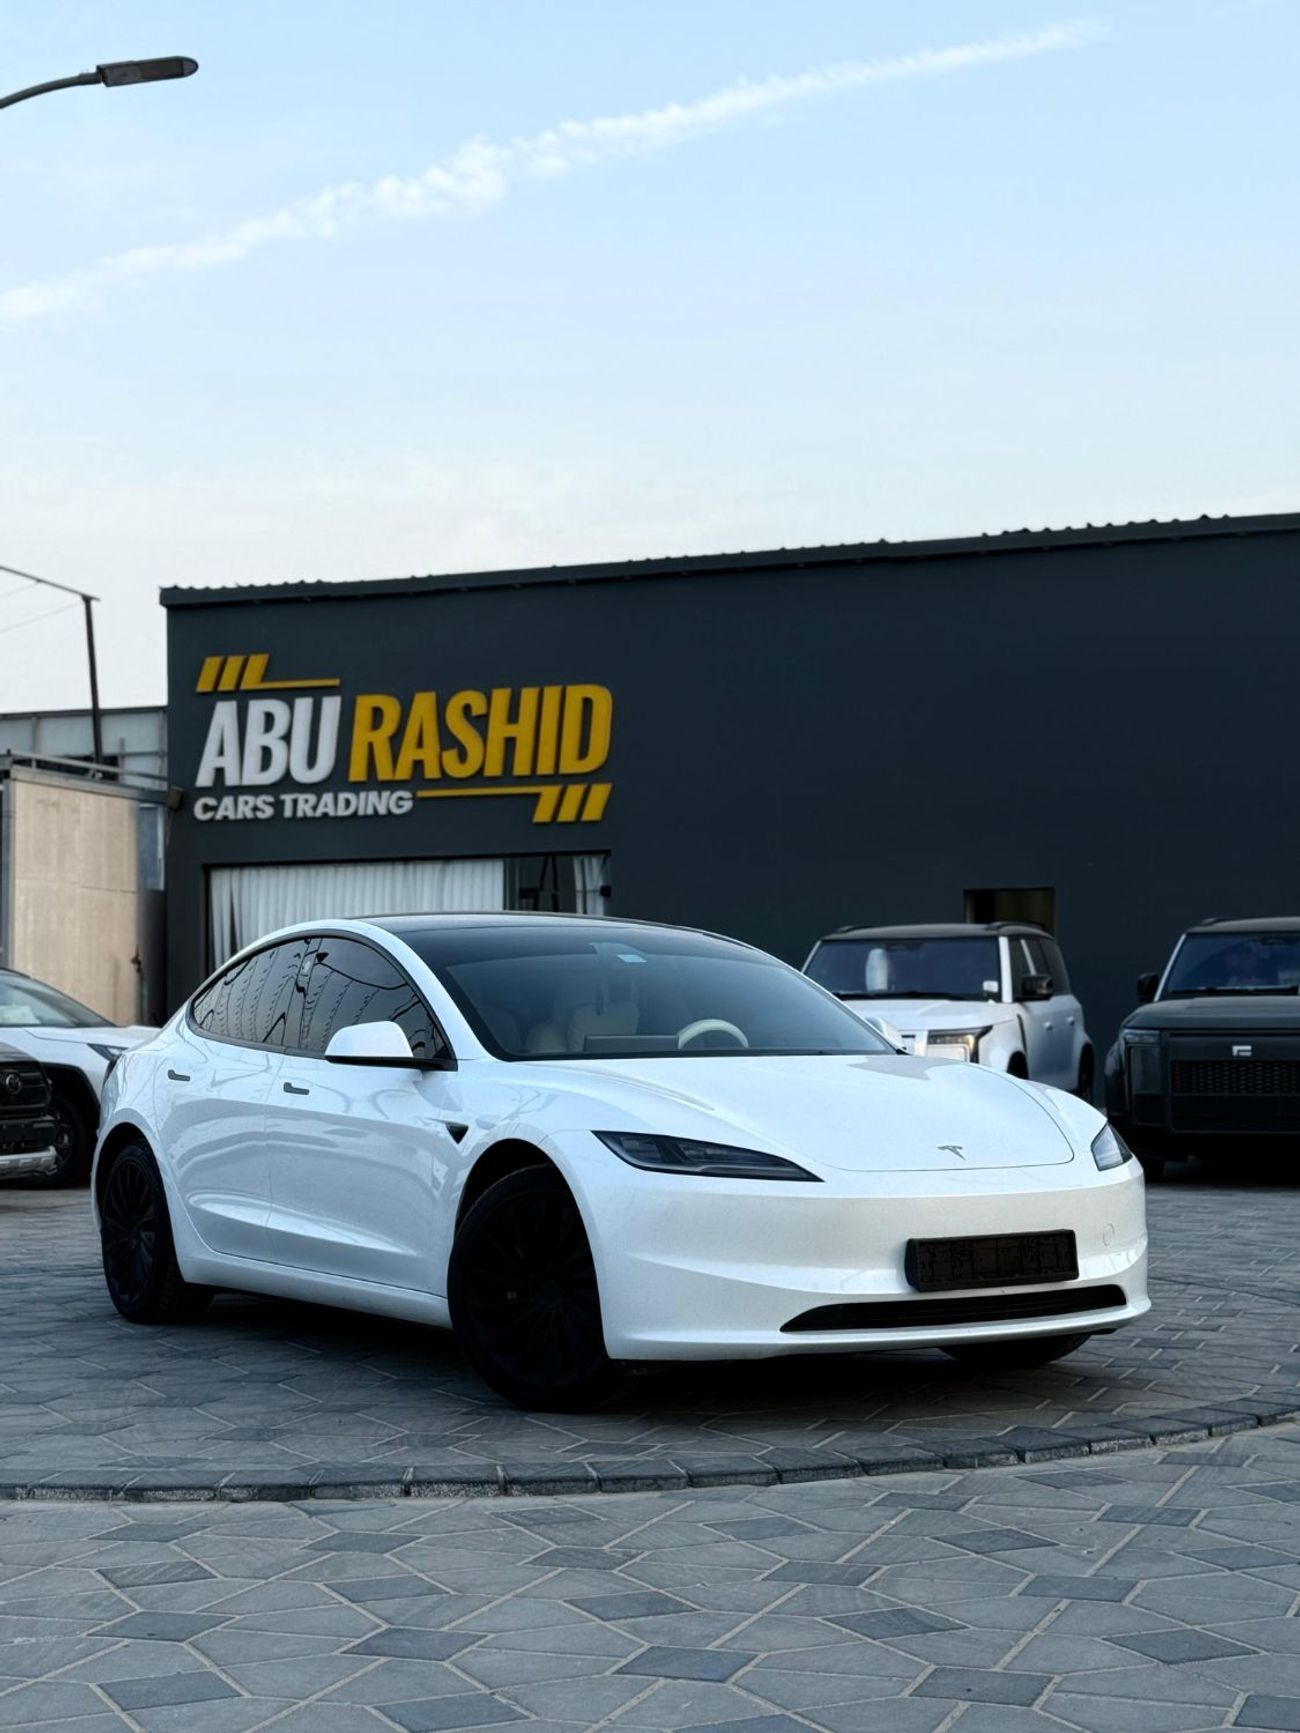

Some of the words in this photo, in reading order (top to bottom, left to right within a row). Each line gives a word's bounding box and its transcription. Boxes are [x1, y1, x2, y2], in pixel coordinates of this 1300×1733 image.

[195, 696, 342, 788] ABU
[348, 684, 613, 782] RASHID
[193, 794, 275, 821] CARS
[279, 790, 414, 818] TRADING
